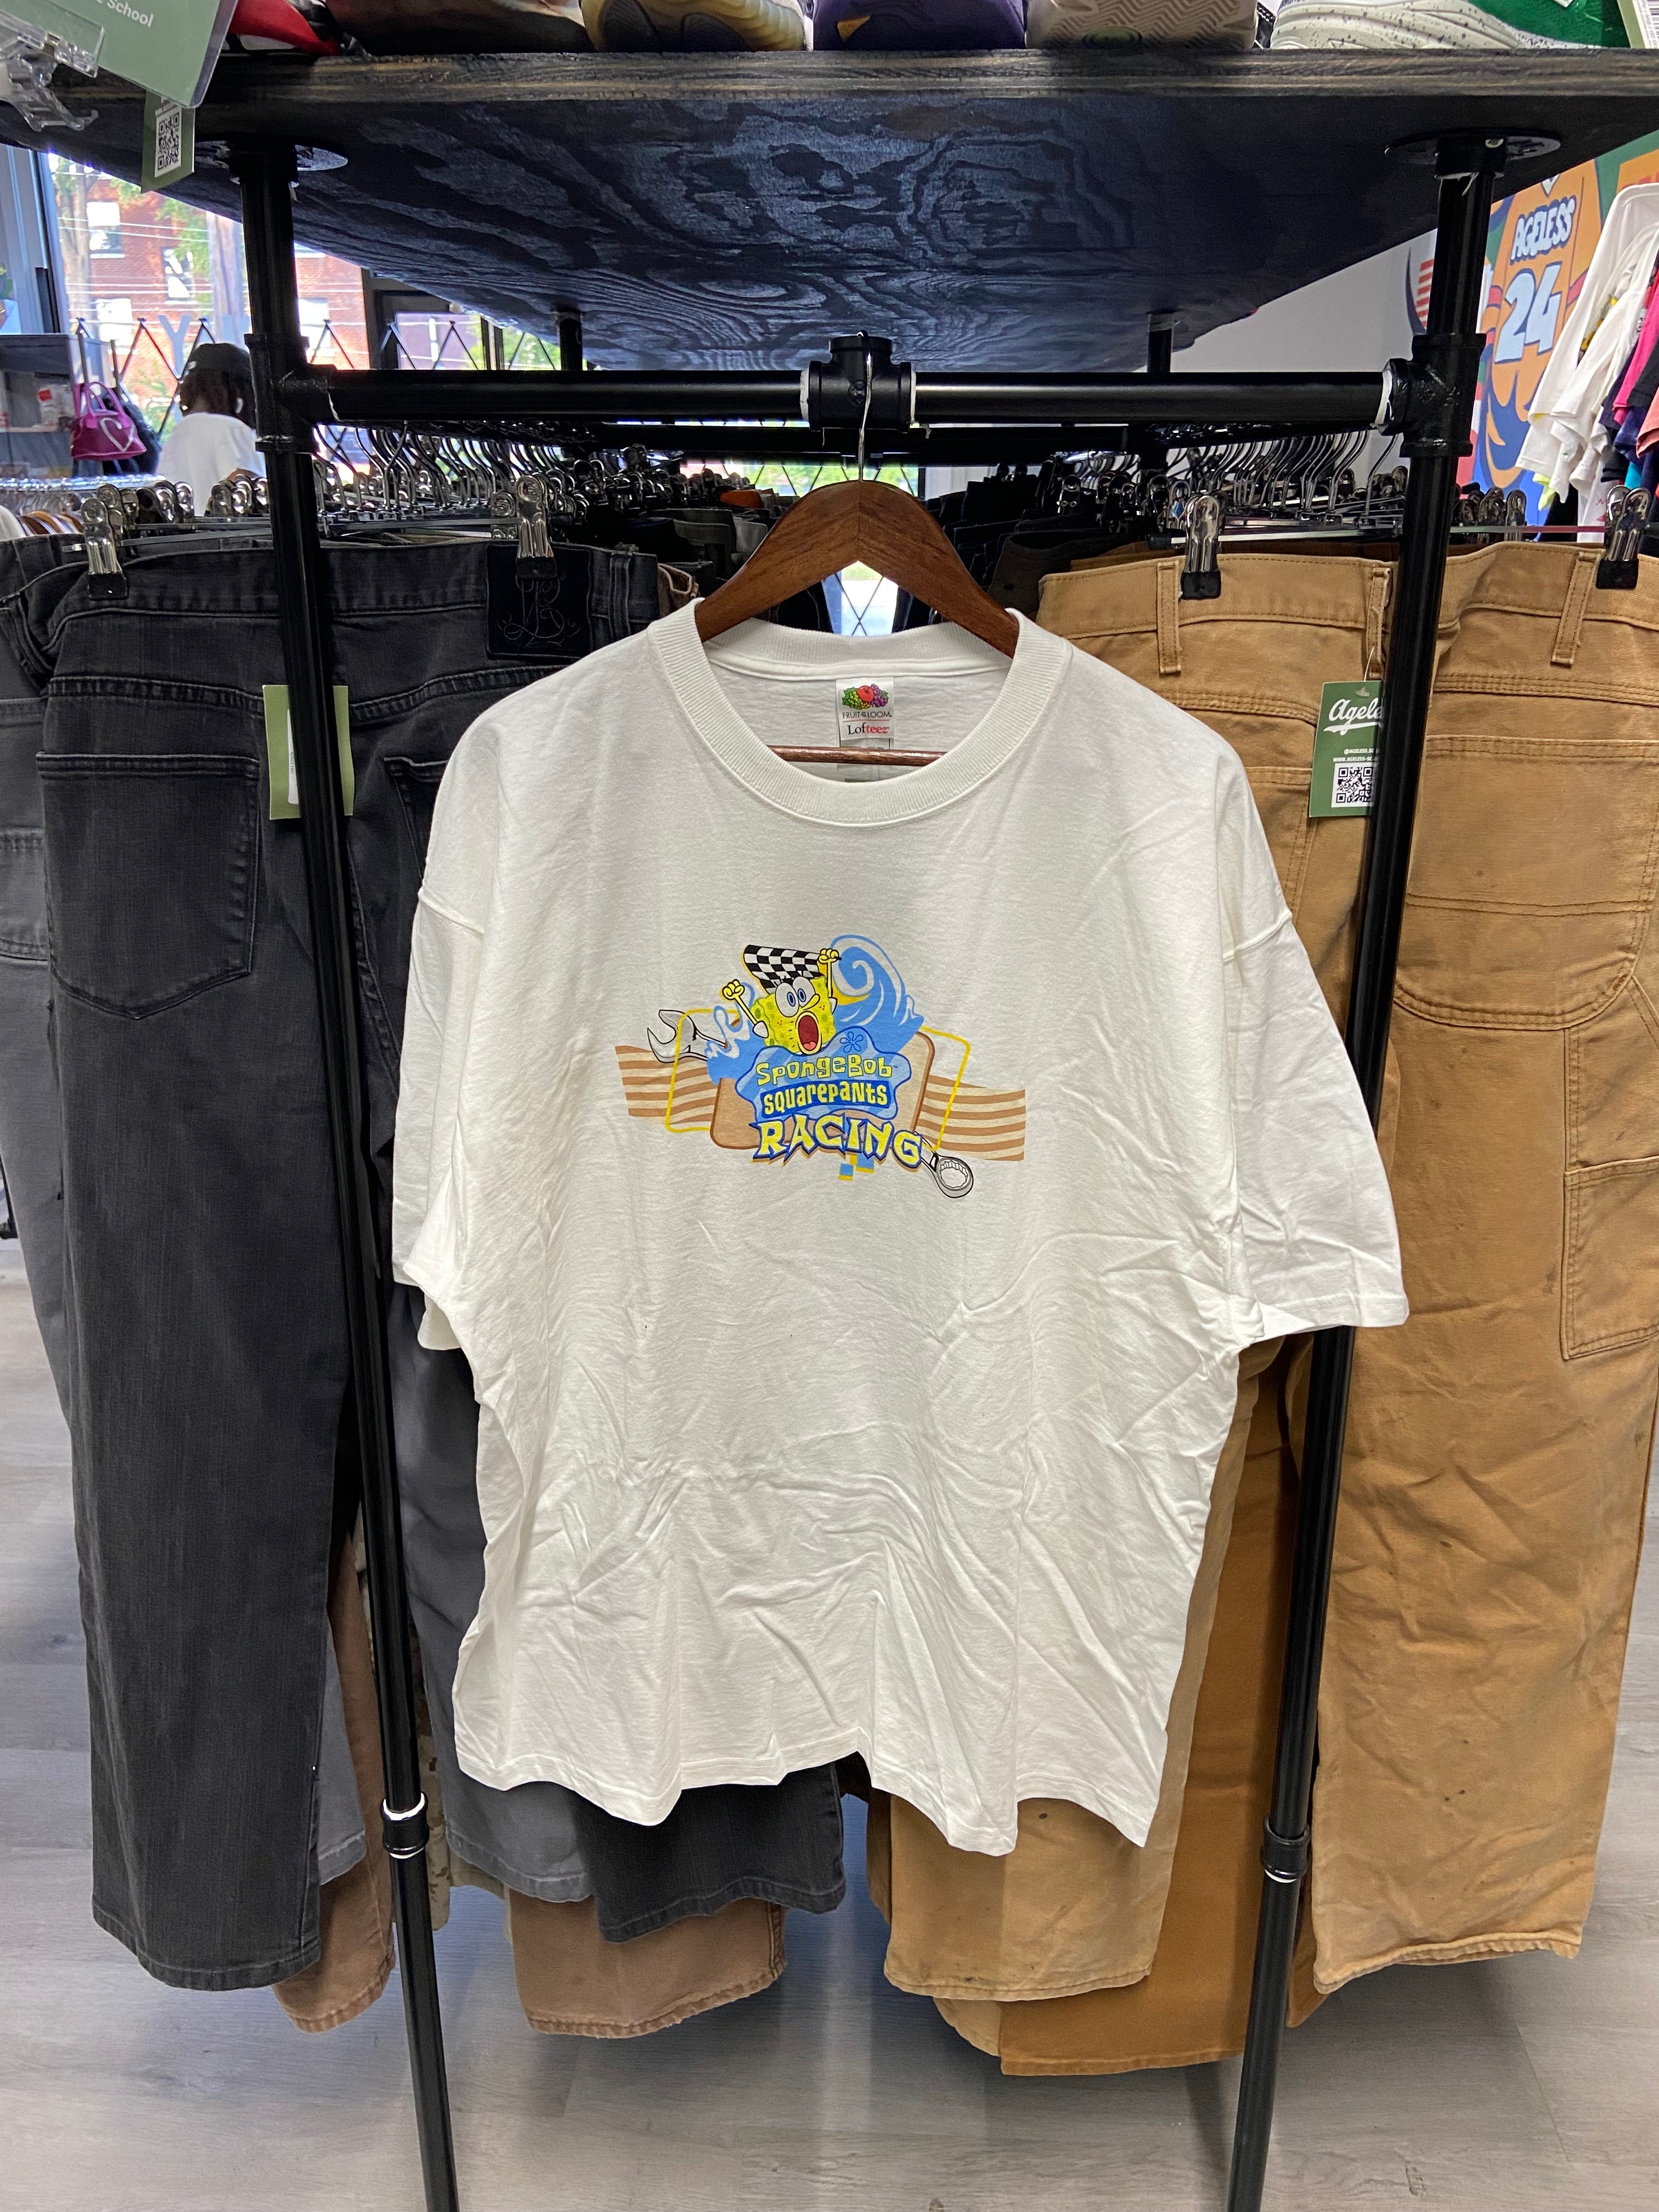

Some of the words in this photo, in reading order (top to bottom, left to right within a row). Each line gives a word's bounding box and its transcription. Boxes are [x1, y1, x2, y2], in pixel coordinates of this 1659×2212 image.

[1510, 196, 1576, 264] AGELESS
[1495, 261, 1562, 364] 24
[842, 711, 860, 719] FRUIT
[847, 721, 888, 735] Lofteez
[1329, 697, 1383, 736] Agele
[756, 1054, 893, 1086] SpongeBob
[749, 1112, 922, 1169] RACING
